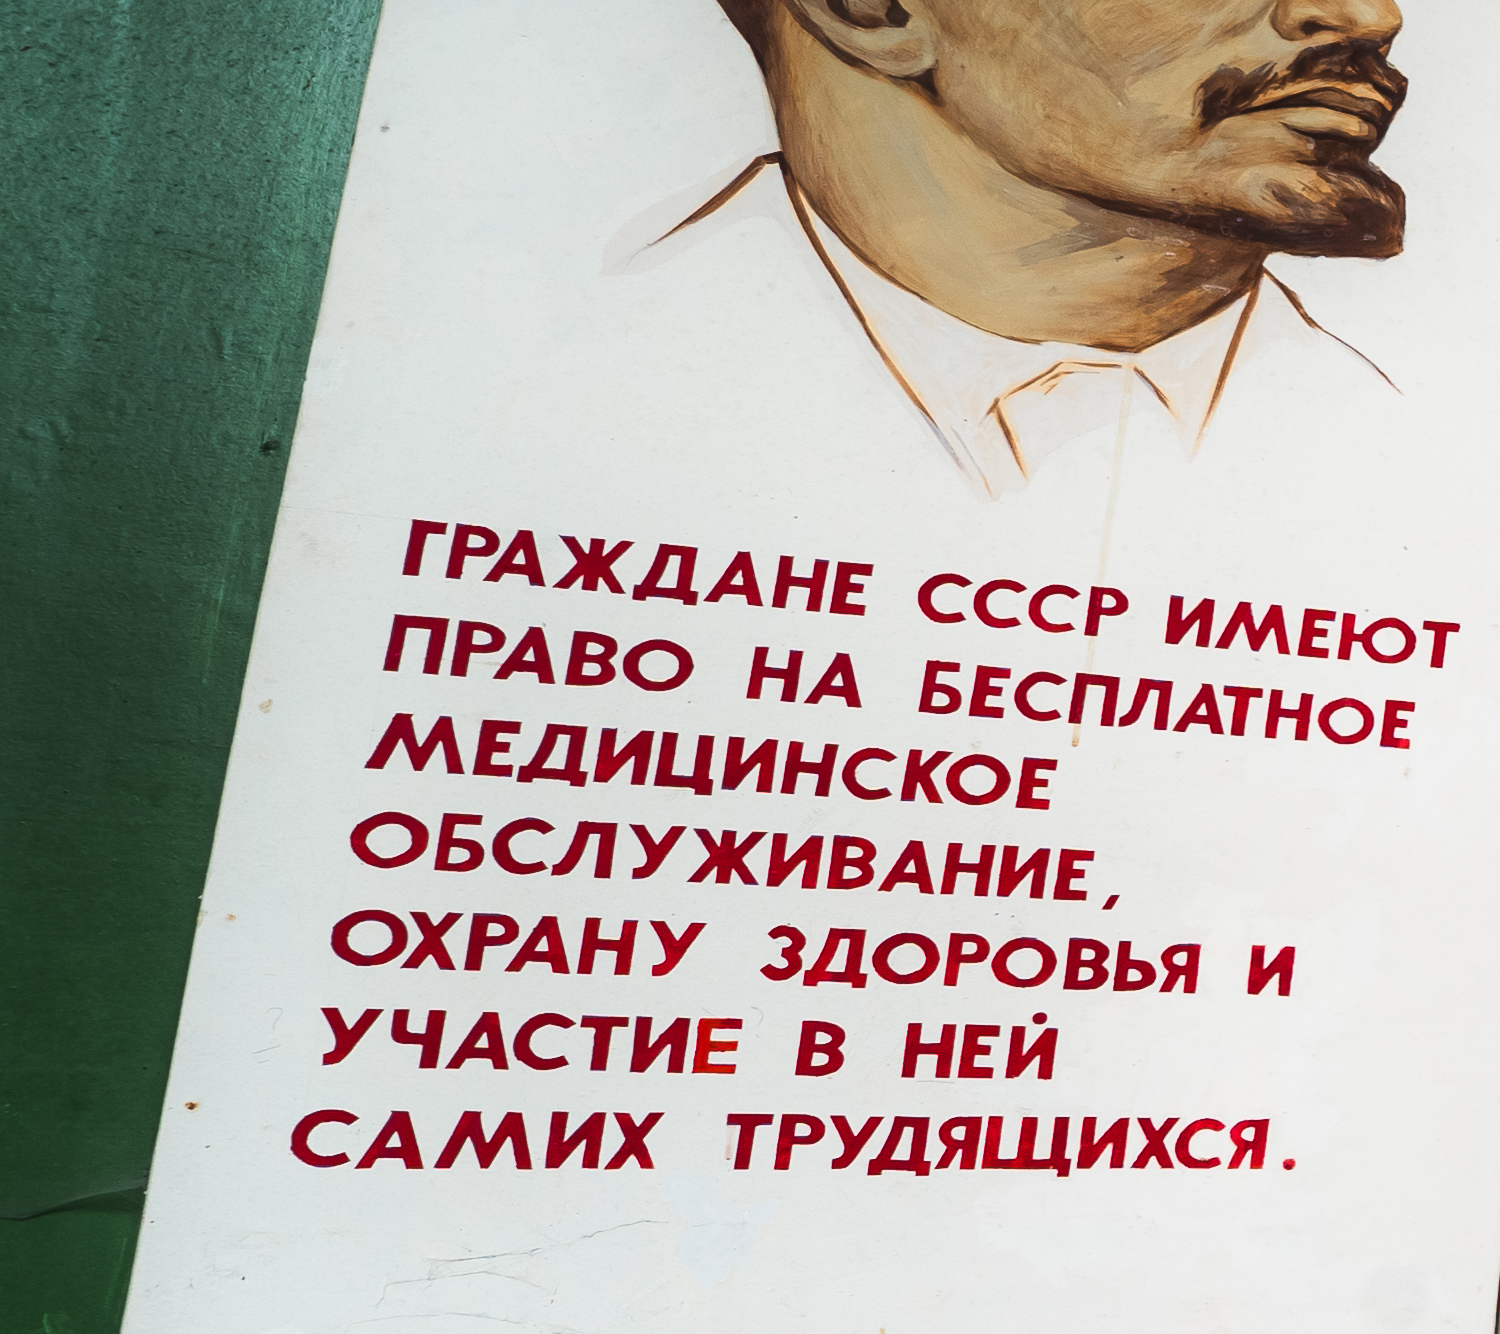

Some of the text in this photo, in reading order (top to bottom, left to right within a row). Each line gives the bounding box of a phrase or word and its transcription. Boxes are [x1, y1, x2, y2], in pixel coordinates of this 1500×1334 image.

[404, 519, 1460, 668] ГРАЖДАНЕ СССР ИМЕЮТ
[383, 615, 1415, 749] ПРАВО НА БЕСПЛАТНОЕ
[365, 713, 1057, 810] МЕДИЦИНСКОЕ
[350, 812, 1118, 910] ОБСЛУЖИВАНИЕ,
[331, 910, 1295, 996] ОХРАНУ ЗДОРОВЬЯ И
[321, 1007, 1058, 1080] УЧАСТИЕ В НЕЙ
[290, 1109, 1295, 1177] САМИХ ТРУДЯЩИХСЯ.
